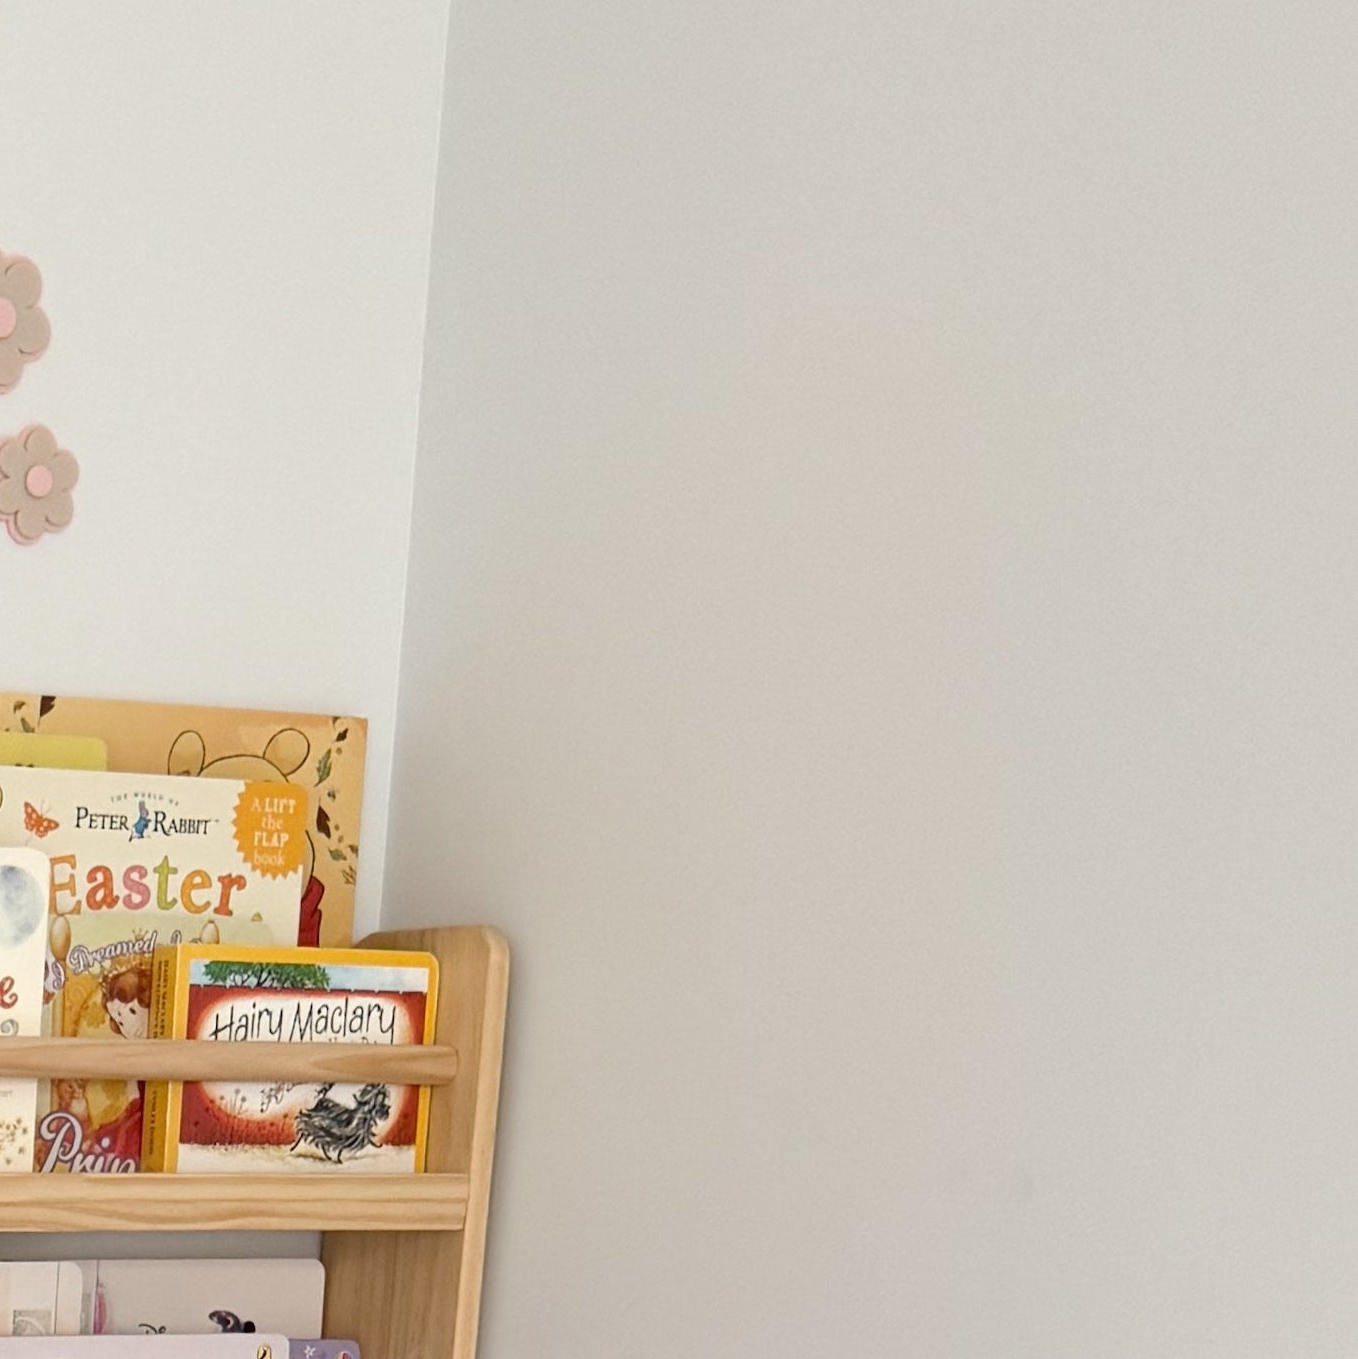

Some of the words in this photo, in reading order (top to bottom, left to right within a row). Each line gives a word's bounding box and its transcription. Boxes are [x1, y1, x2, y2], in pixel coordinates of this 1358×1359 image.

[75, 806, 129, 833] PETER
[152, 811, 212, 836] RABBIT
[210, 1000, 283, 1042] Hairy
[290, 997, 396, 1045] Maclary
